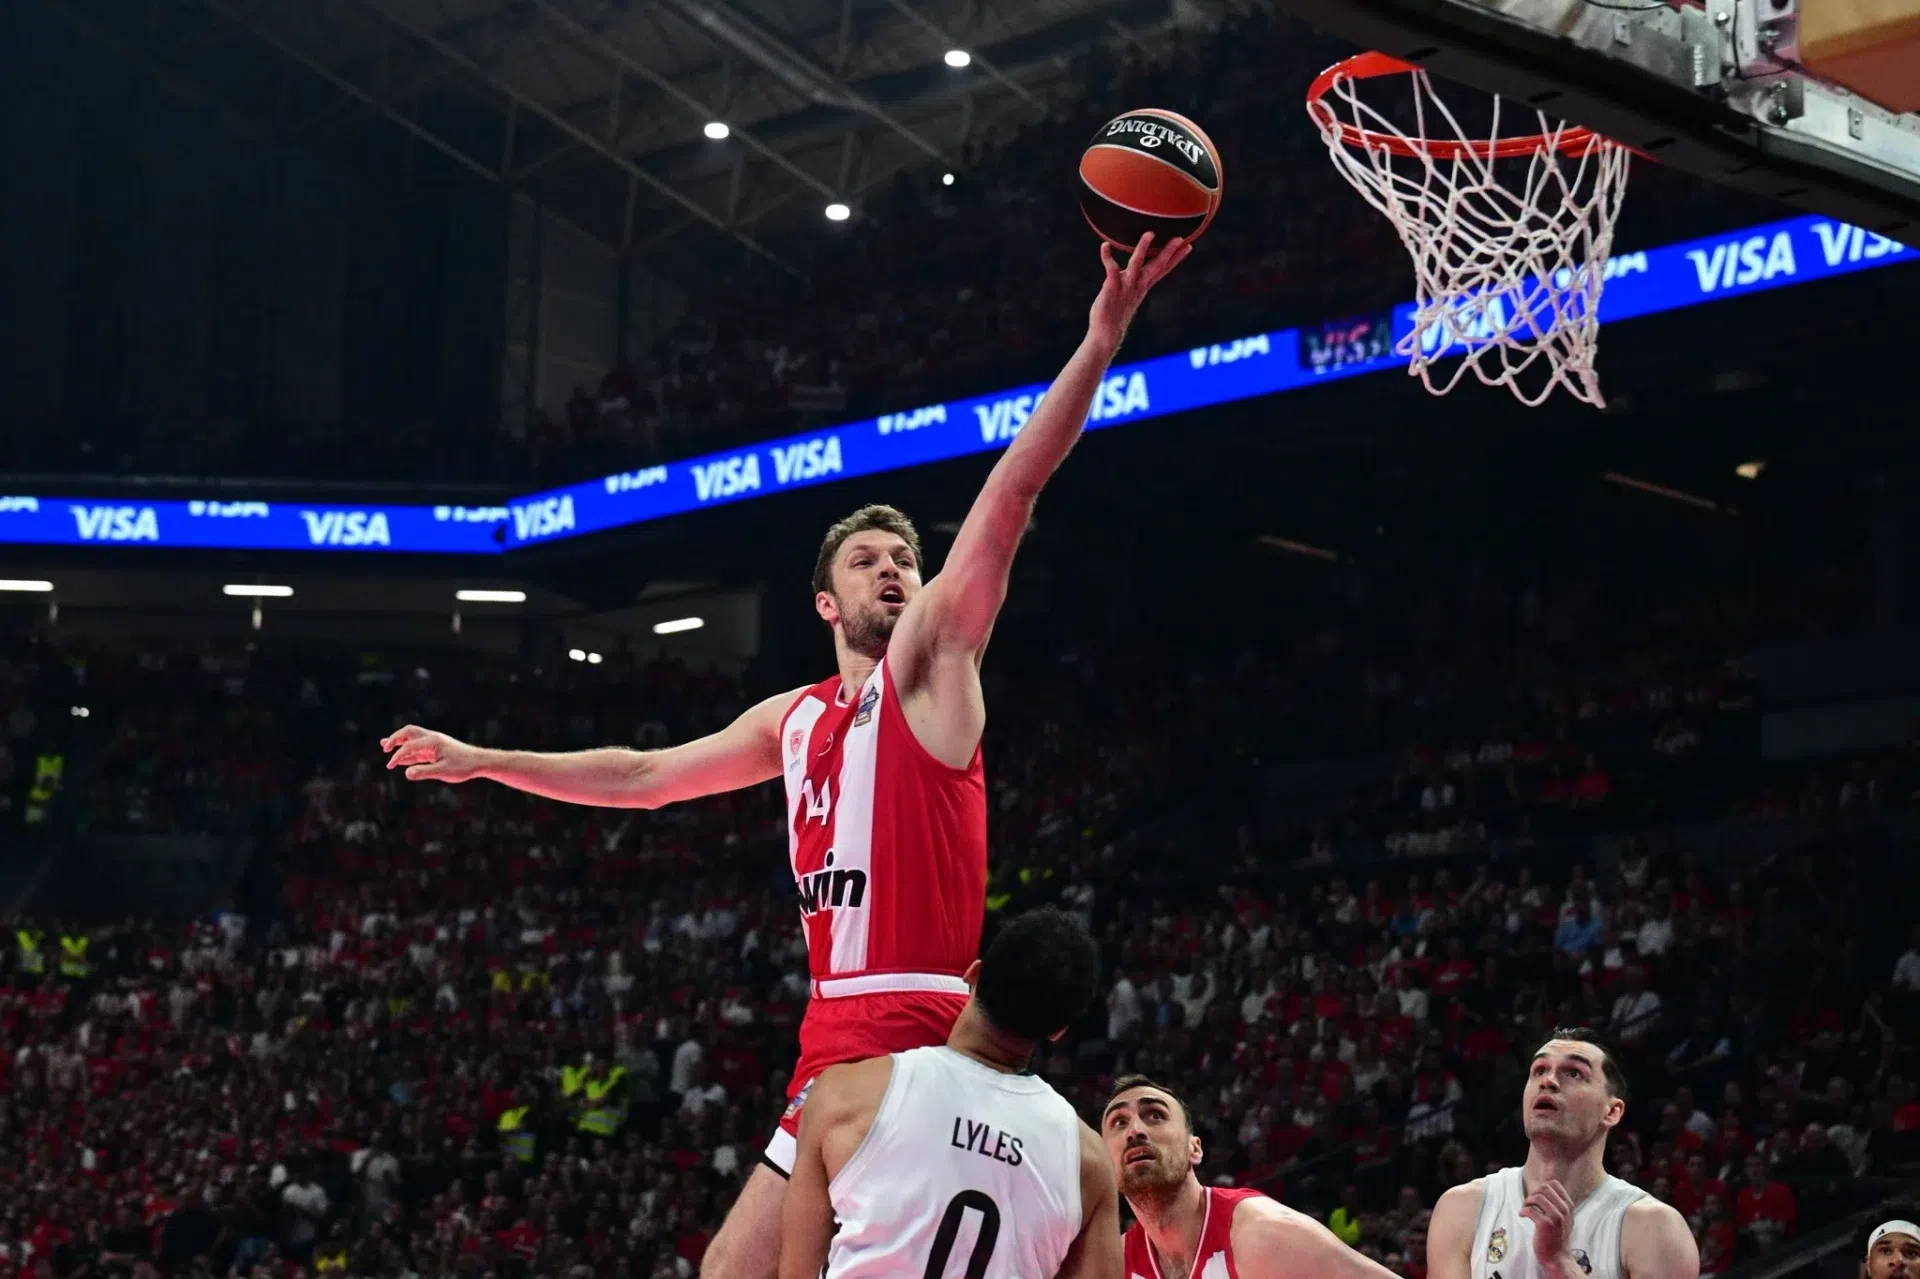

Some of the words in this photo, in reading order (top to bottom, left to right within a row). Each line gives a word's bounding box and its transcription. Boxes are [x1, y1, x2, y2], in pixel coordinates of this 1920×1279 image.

[1106, 119, 1204, 164] SPALDING
[1685, 231, 1797, 292] VISA
[1809, 222, 1904, 267] VIS
[1091, 372, 1150, 422] ISA
[691, 454, 761, 501] VISA
[770, 436, 843, 484] VISA
[69, 505, 160, 541] VISA
[300, 510, 391, 546] VISA
[512, 494, 575, 540] VISA
[800, 776, 831, 826] 14
[951, 1116, 1023, 1167] LYLES
[922, 1189, 1001, 1279] 0
